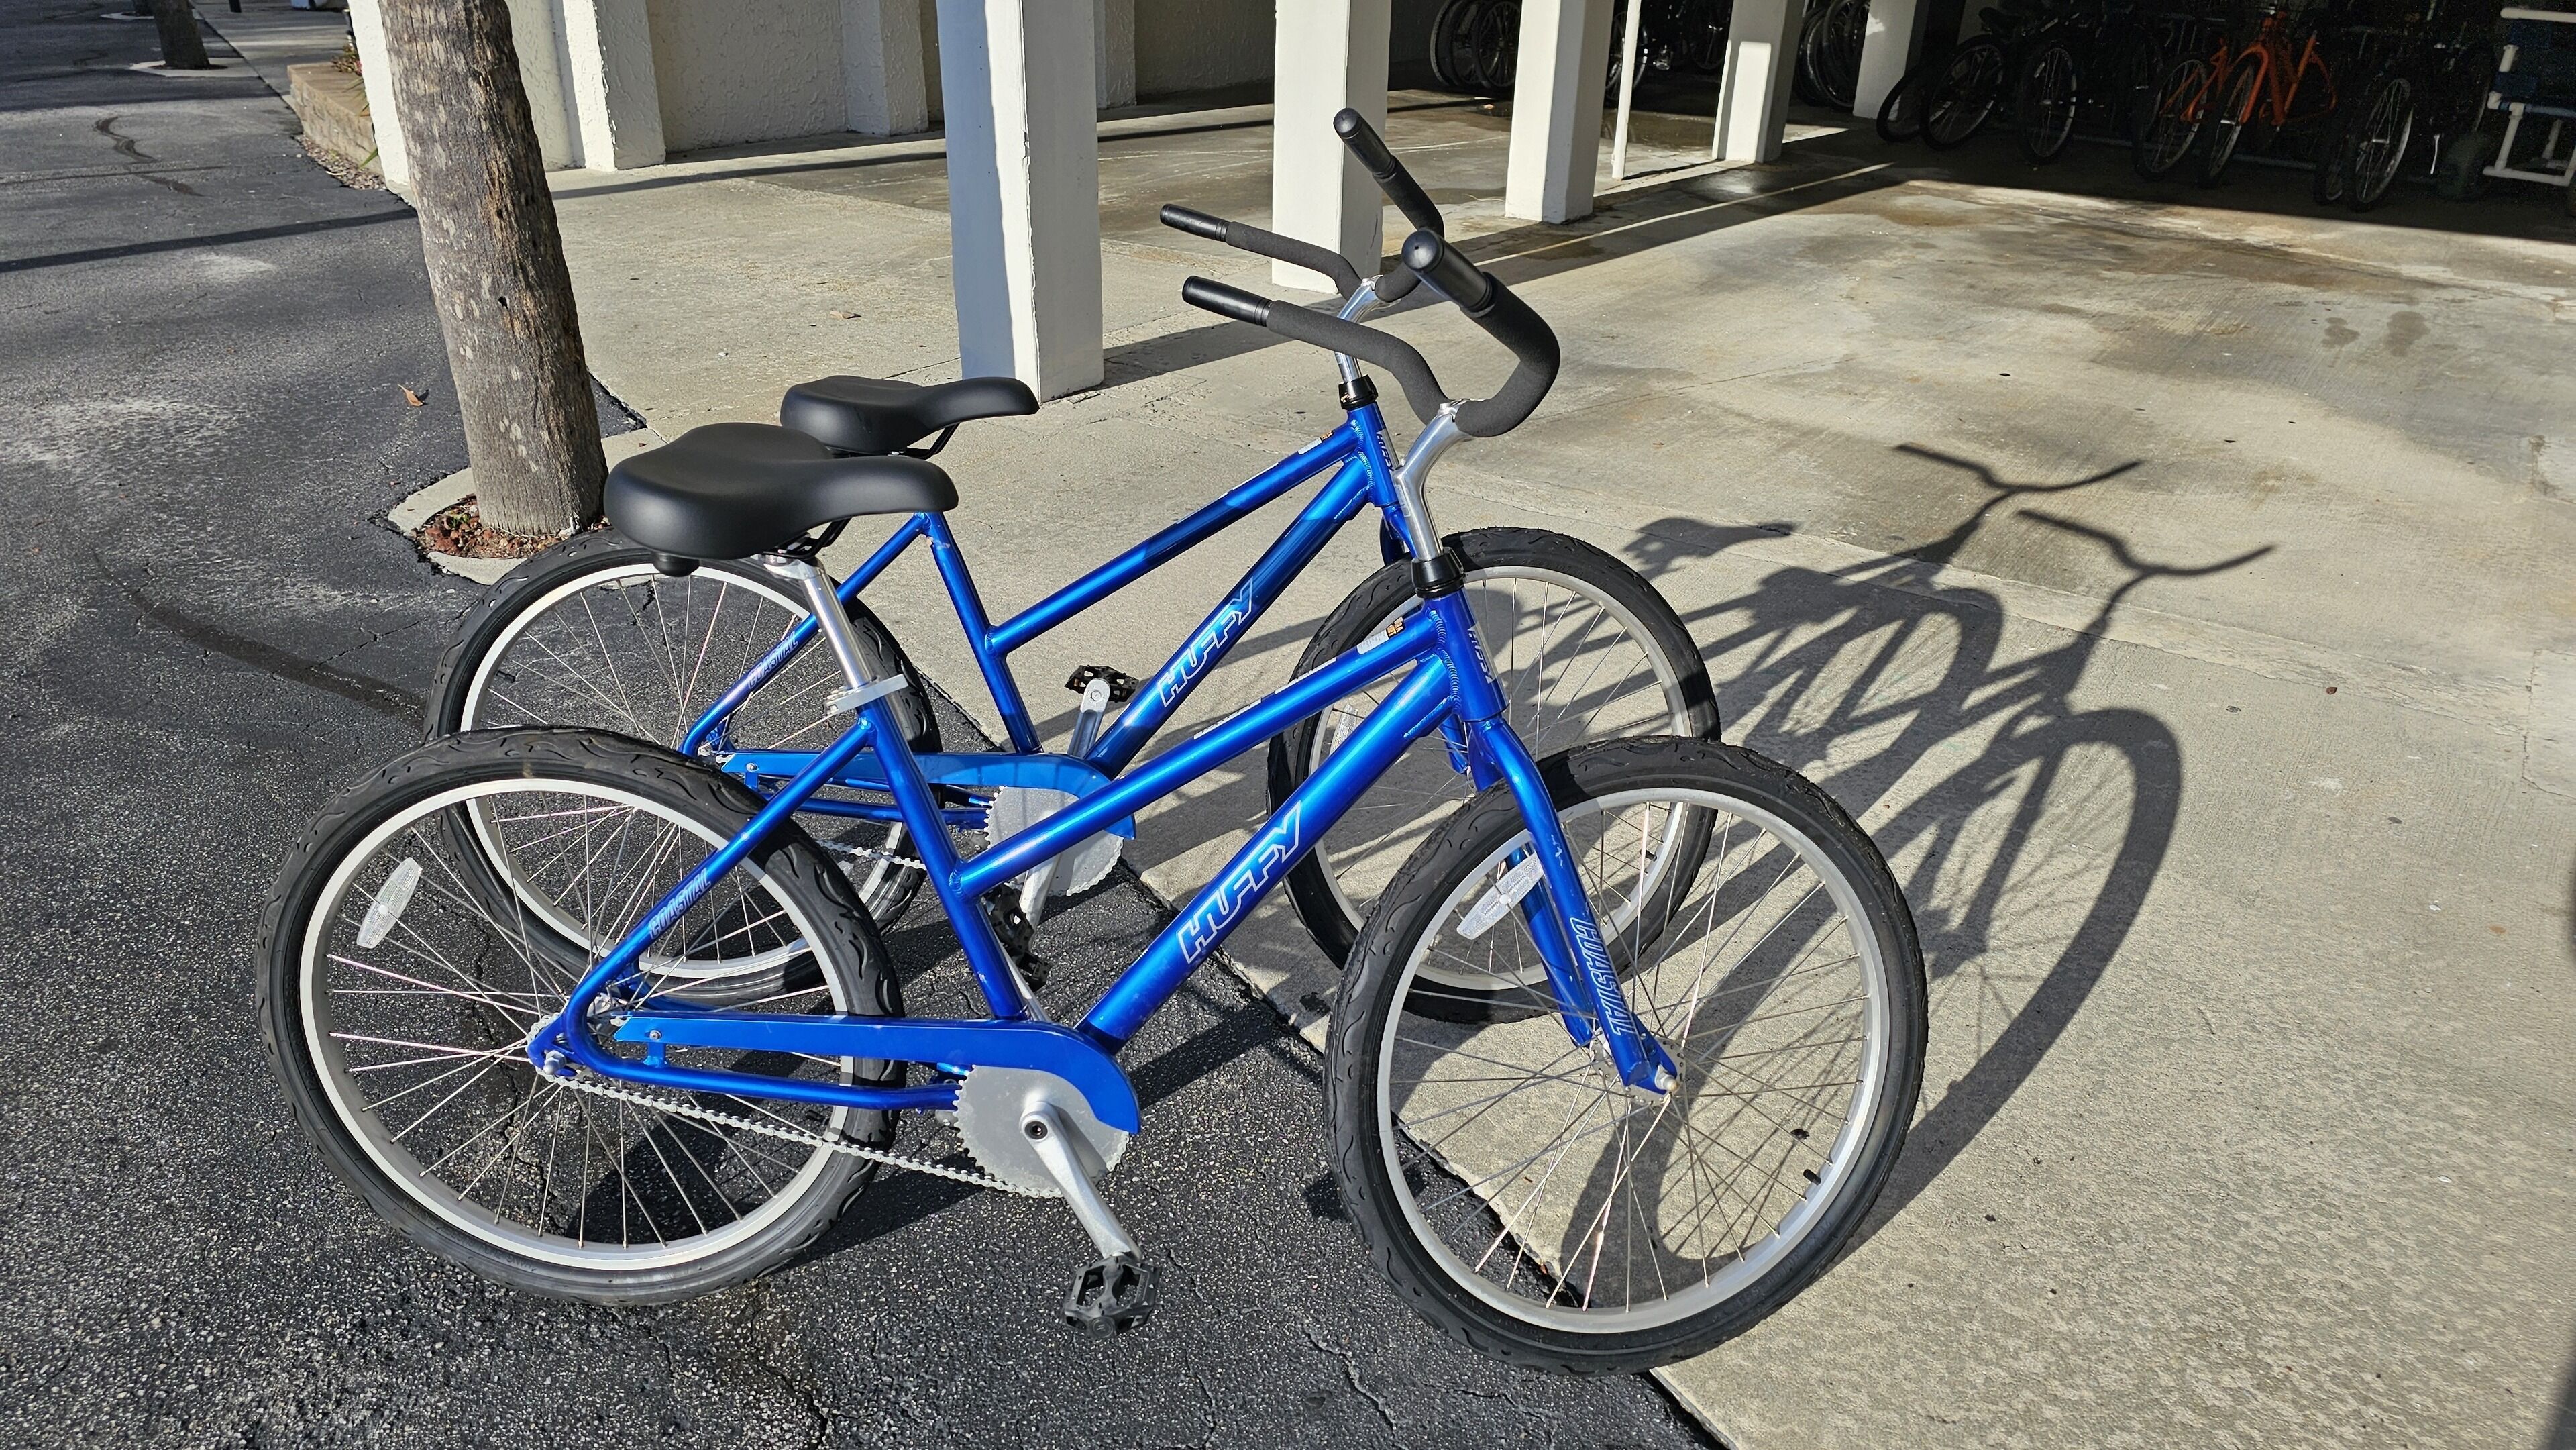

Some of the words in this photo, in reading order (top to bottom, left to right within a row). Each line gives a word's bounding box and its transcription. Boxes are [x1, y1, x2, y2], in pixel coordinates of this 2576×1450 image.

[747, 631, 798, 689] COASTAL
[1157, 576, 1254, 708] HUFFY
[648, 868, 711, 939] COASTAL
[1177, 800, 1301, 964] HUFFY
[1570, 917, 1636, 1035] COASTAL
